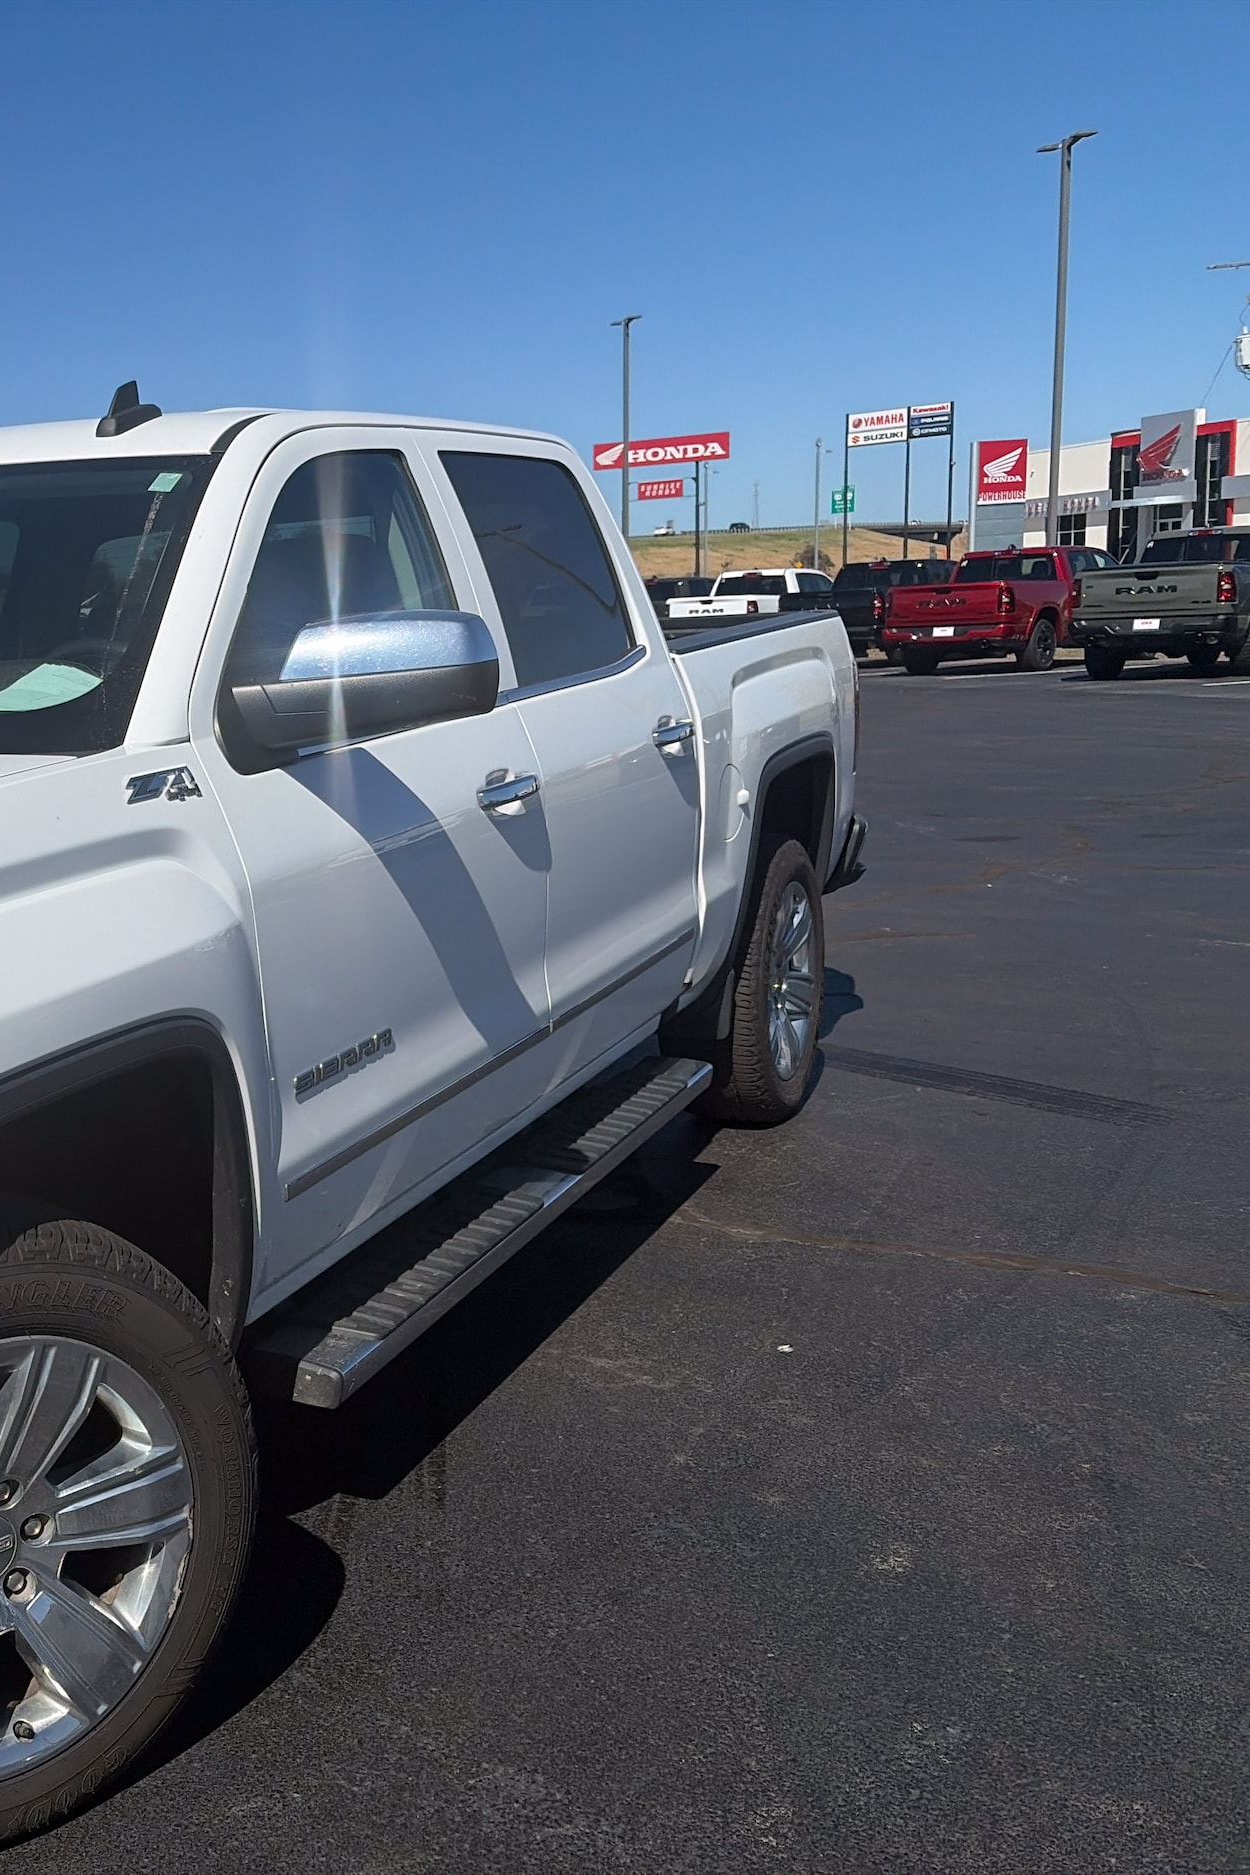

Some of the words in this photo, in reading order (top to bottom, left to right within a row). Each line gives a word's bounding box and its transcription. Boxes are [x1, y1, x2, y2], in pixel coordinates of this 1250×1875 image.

[912, 404, 949, 413] Kawasaki
[863, 413, 904, 427] YAMAHA
[863, 431, 904, 442] SUZUKI
[627, 442, 726, 464] HONDA
[983, 476, 1023, 484] HONDA
[645, 487, 676, 497] HONDA
[978, 489, 1026, 502] POWERHOUSE
[1115, 585, 1178, 596] RAM
